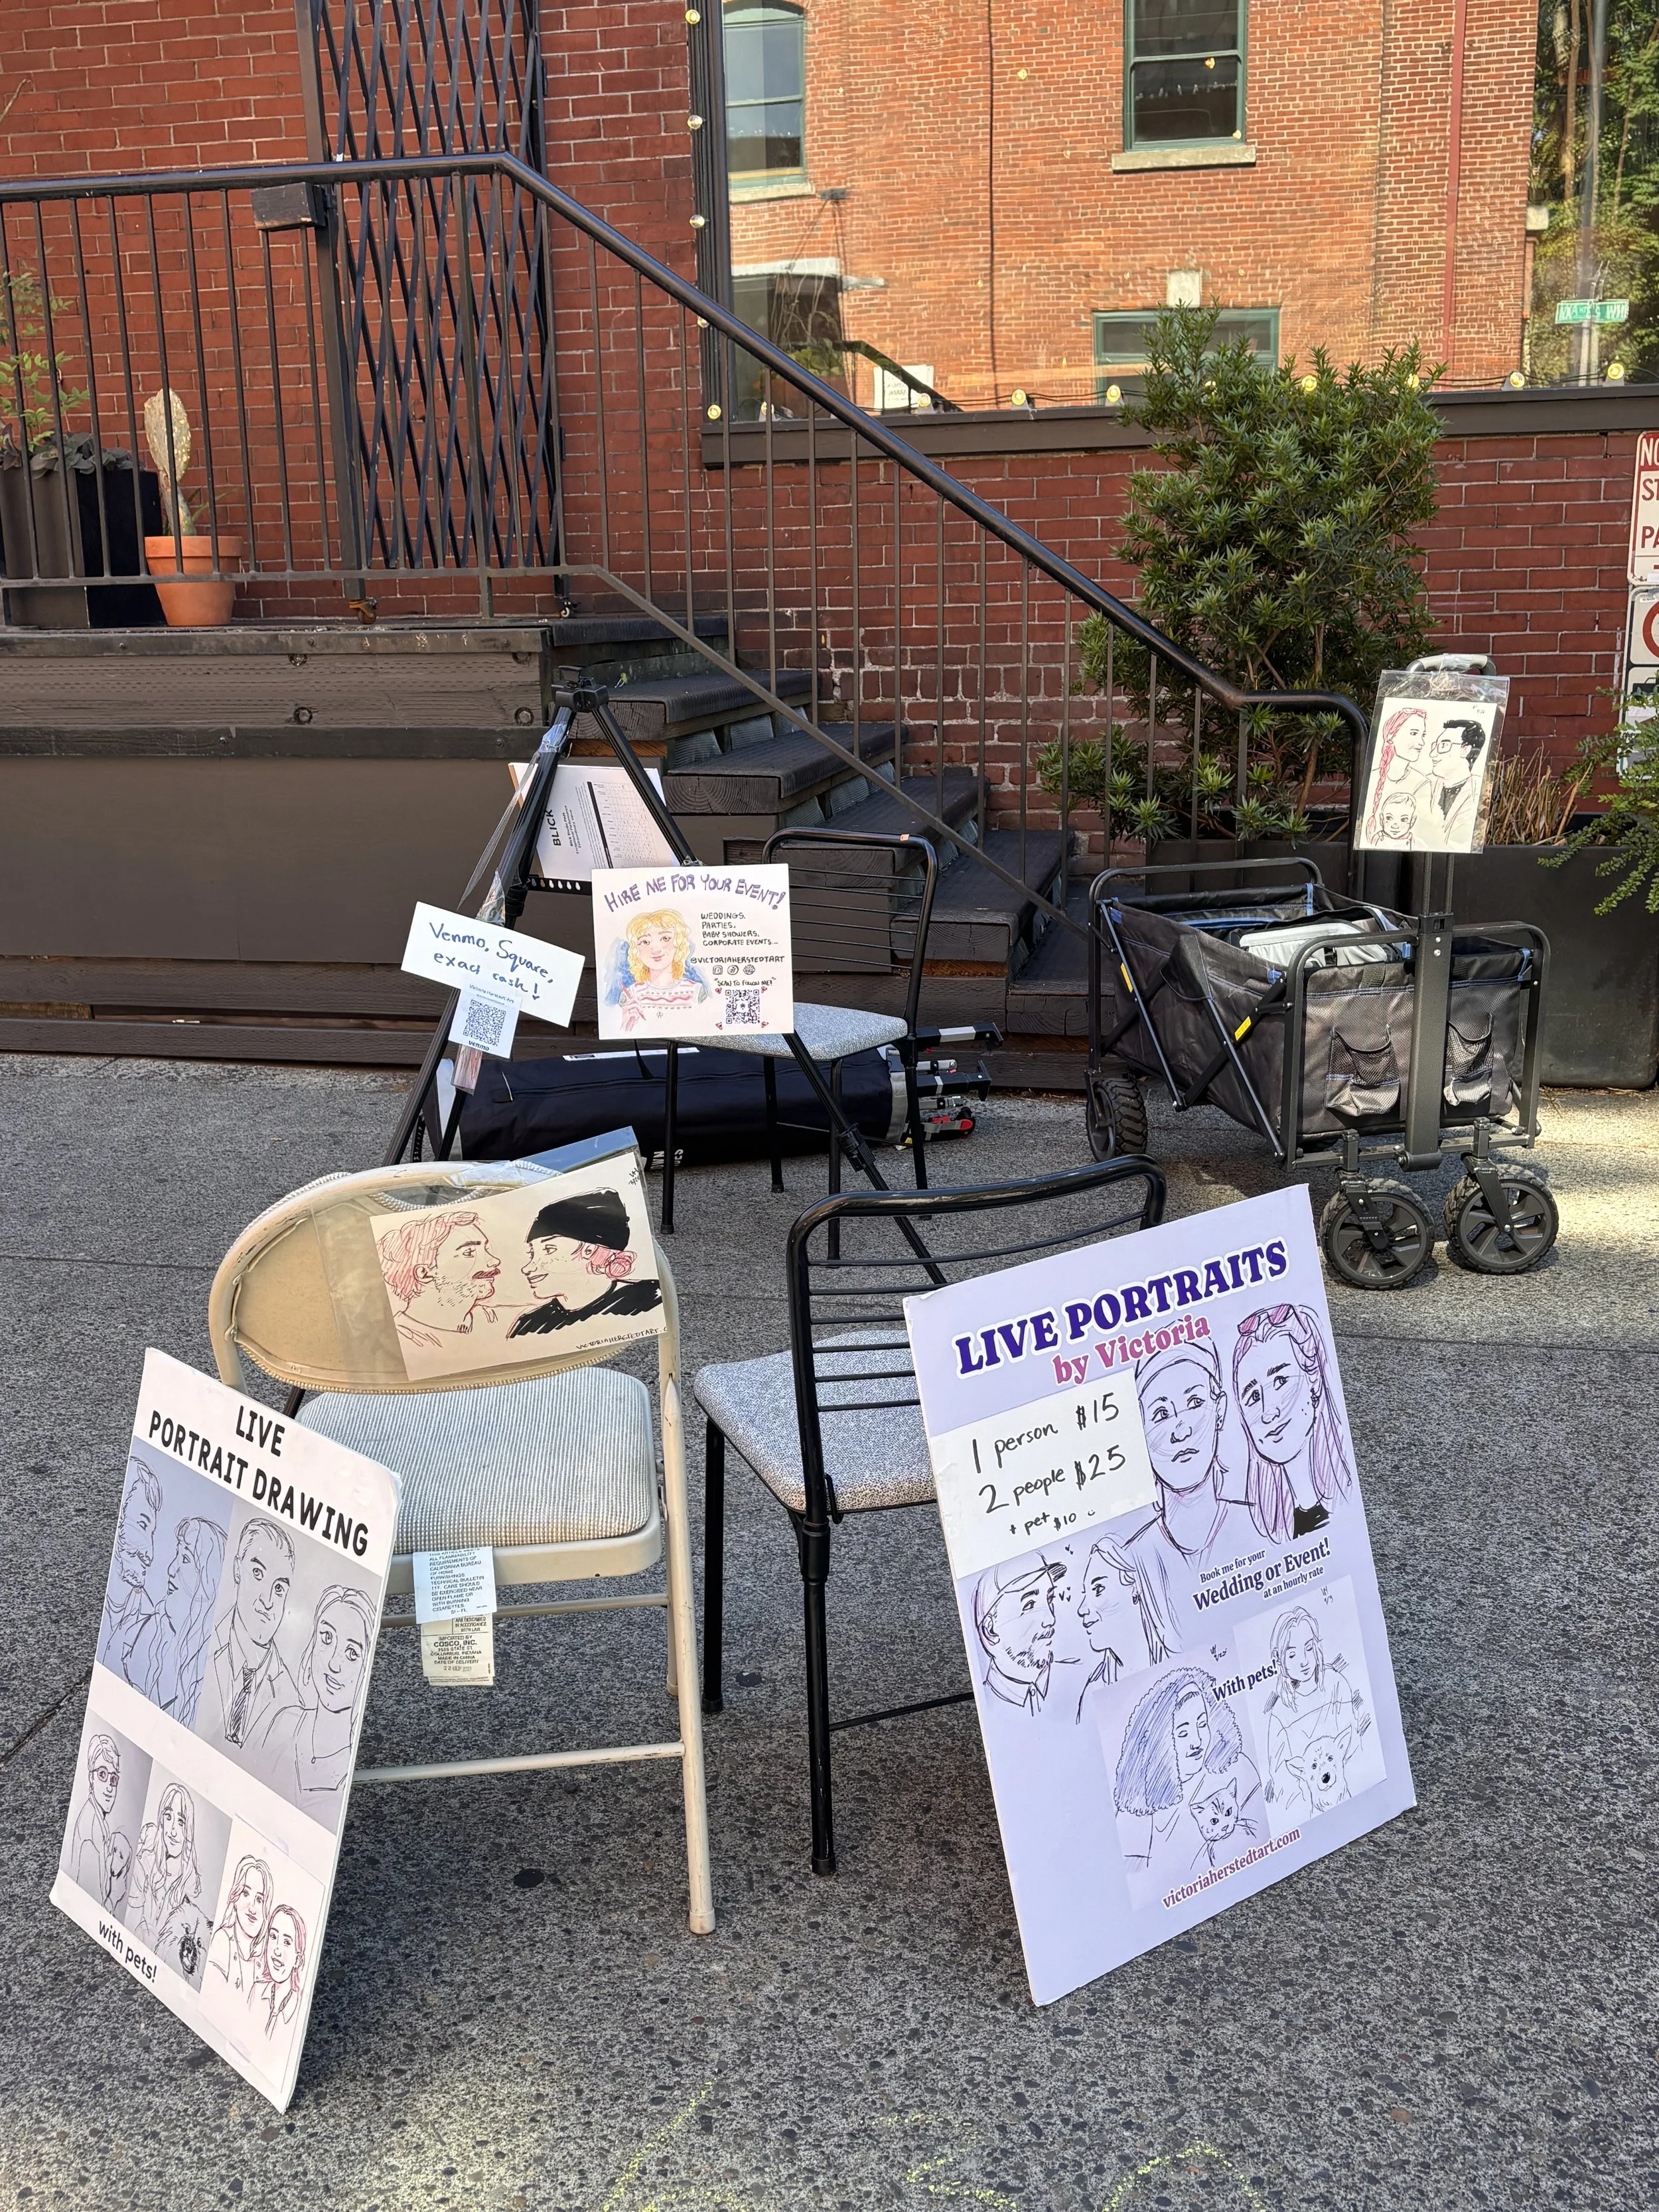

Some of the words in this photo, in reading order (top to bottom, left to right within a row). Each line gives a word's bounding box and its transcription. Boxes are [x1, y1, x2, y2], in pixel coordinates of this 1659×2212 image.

[545, 809, 562, 846] BLICK
[604, 884, 641, 913] HIRE
[646, 876, 666, 896] ME
[670, 873, 695, 893] FOR
[701, 874, 732, 892] YOUR
[735, 878, 786, 910] EVENT!
[429, 922, 490, 952] Venmo,
[496, 940, 553, 984] Square,
[433, 952, 480, 975] exact
[469, 1040, 490, 1051] venmo
[954, 1310, 1060, 1374] LIVE
[1065, 1240, 1287, 1340] PORTRAITS
[1052, 1355, 1089, 1386] by
[1095, 1315, 1211, 1369] Victoria
[236, 1406, 285, 1457] LIVE
[972, 1439, 981, 1473] 1
[994, 1424, 1058, 1469] person
[1075, 1392, 1119, 1431] $15
[149, 1410, 249, 1489] PORTRAIT
[252, 1468, 368, 1557] DRAWING
[978, 1484, 1009, 1514] 2
[1013, 1468, 1066, 1507] people
[1074, 1444, 1126, 1491] $25
[1024, 1512, 1050, 1536] pet
[1054, 1513, 1077, 1532] $10
[1192, 1570, 1264, 1611] Wedding
[1265, 1564, 1281, 1582] or
[1283, 1536, 1331, 1574] Event!
[1199, 1569, 1221, 1584] Book
[1222, 1562, 1234, 1574] me
[1234, 1556, 1247, 1570] for
[1247, 1549, 1266, 1566] your
[1263, 1587, 1271, 1599] at
[1272, 1584, 1283, 1595] an
[1283, 1572, 1309, 1591] hourly
[1308, 1566, 1325, 1580] rate
[1212, 1676, 1246, 1702] With
[1246, 1659, 1278, 1690] pets!
[1162, 1828, 1301, 1909] victoriaherstedtart.com
[99, 1921, 123, 1954] with
[125, 1946, 157, 1983] pets!
